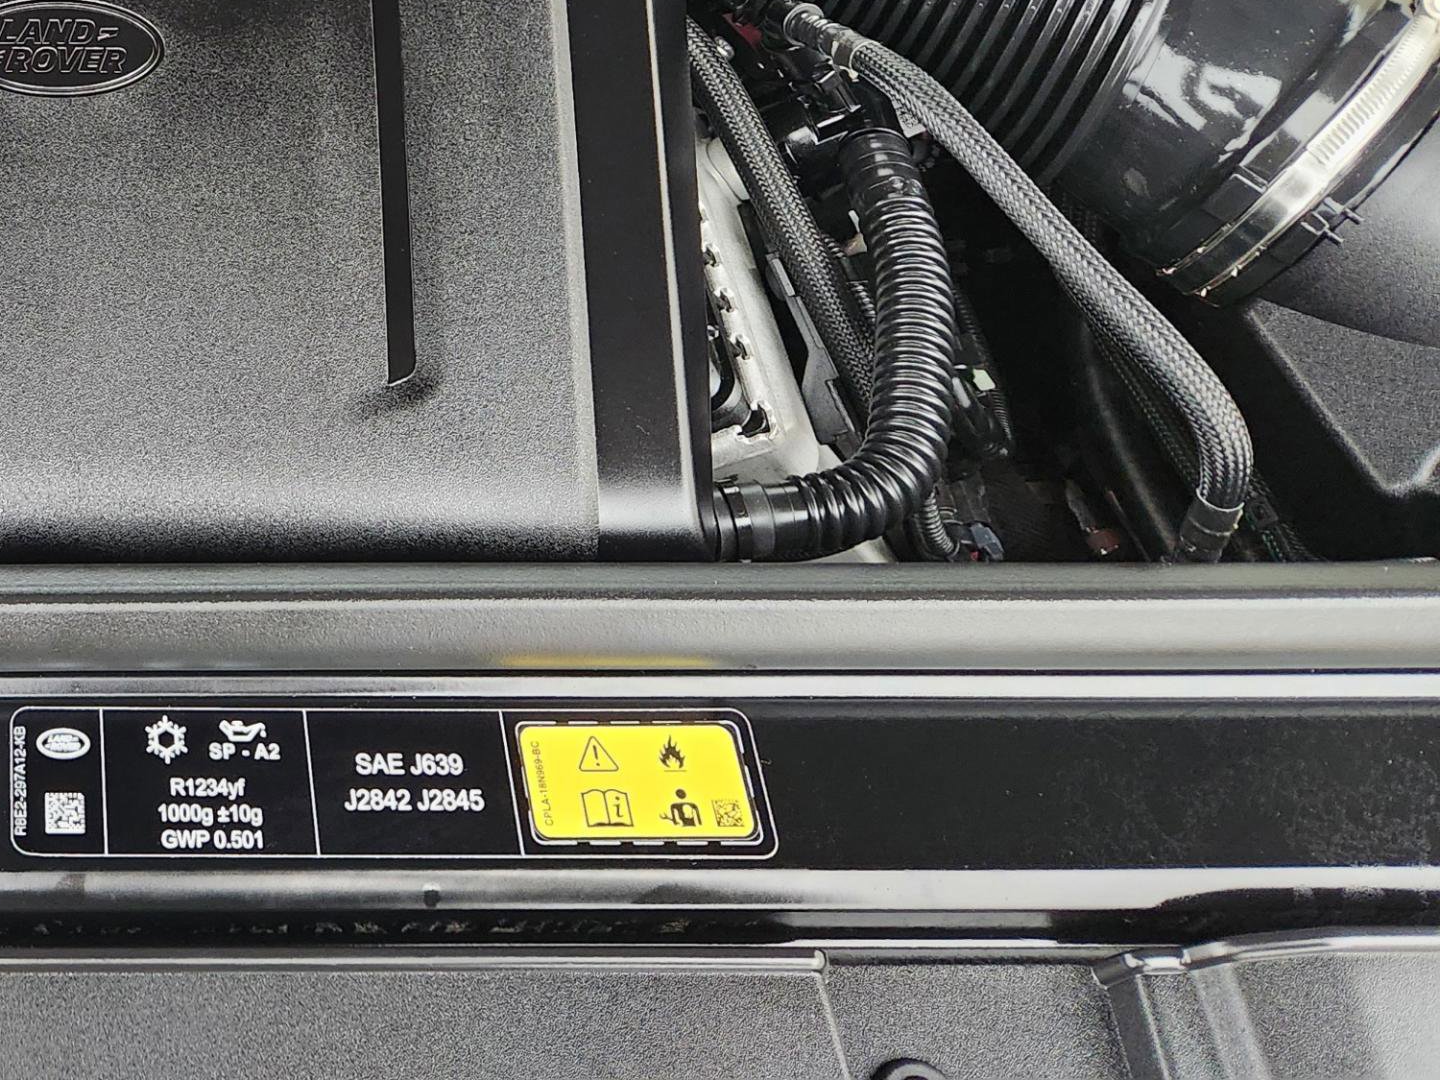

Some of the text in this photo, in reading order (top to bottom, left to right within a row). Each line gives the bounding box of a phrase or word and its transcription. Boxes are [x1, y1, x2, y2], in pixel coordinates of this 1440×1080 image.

[5, 46, 127, 73] ROVER
[209, 742, 236, 760] SP
[254, 742, 280, 760] A2
[355, 752, 464, 776] SAE J639
[170, 777, 246, 800] R1234yf
[344, 788, 486, 811] J2842 J2845
[158, 803, 263, 827] 1000g ±10g
[161, 829, 264, 849] GWP 0.501
